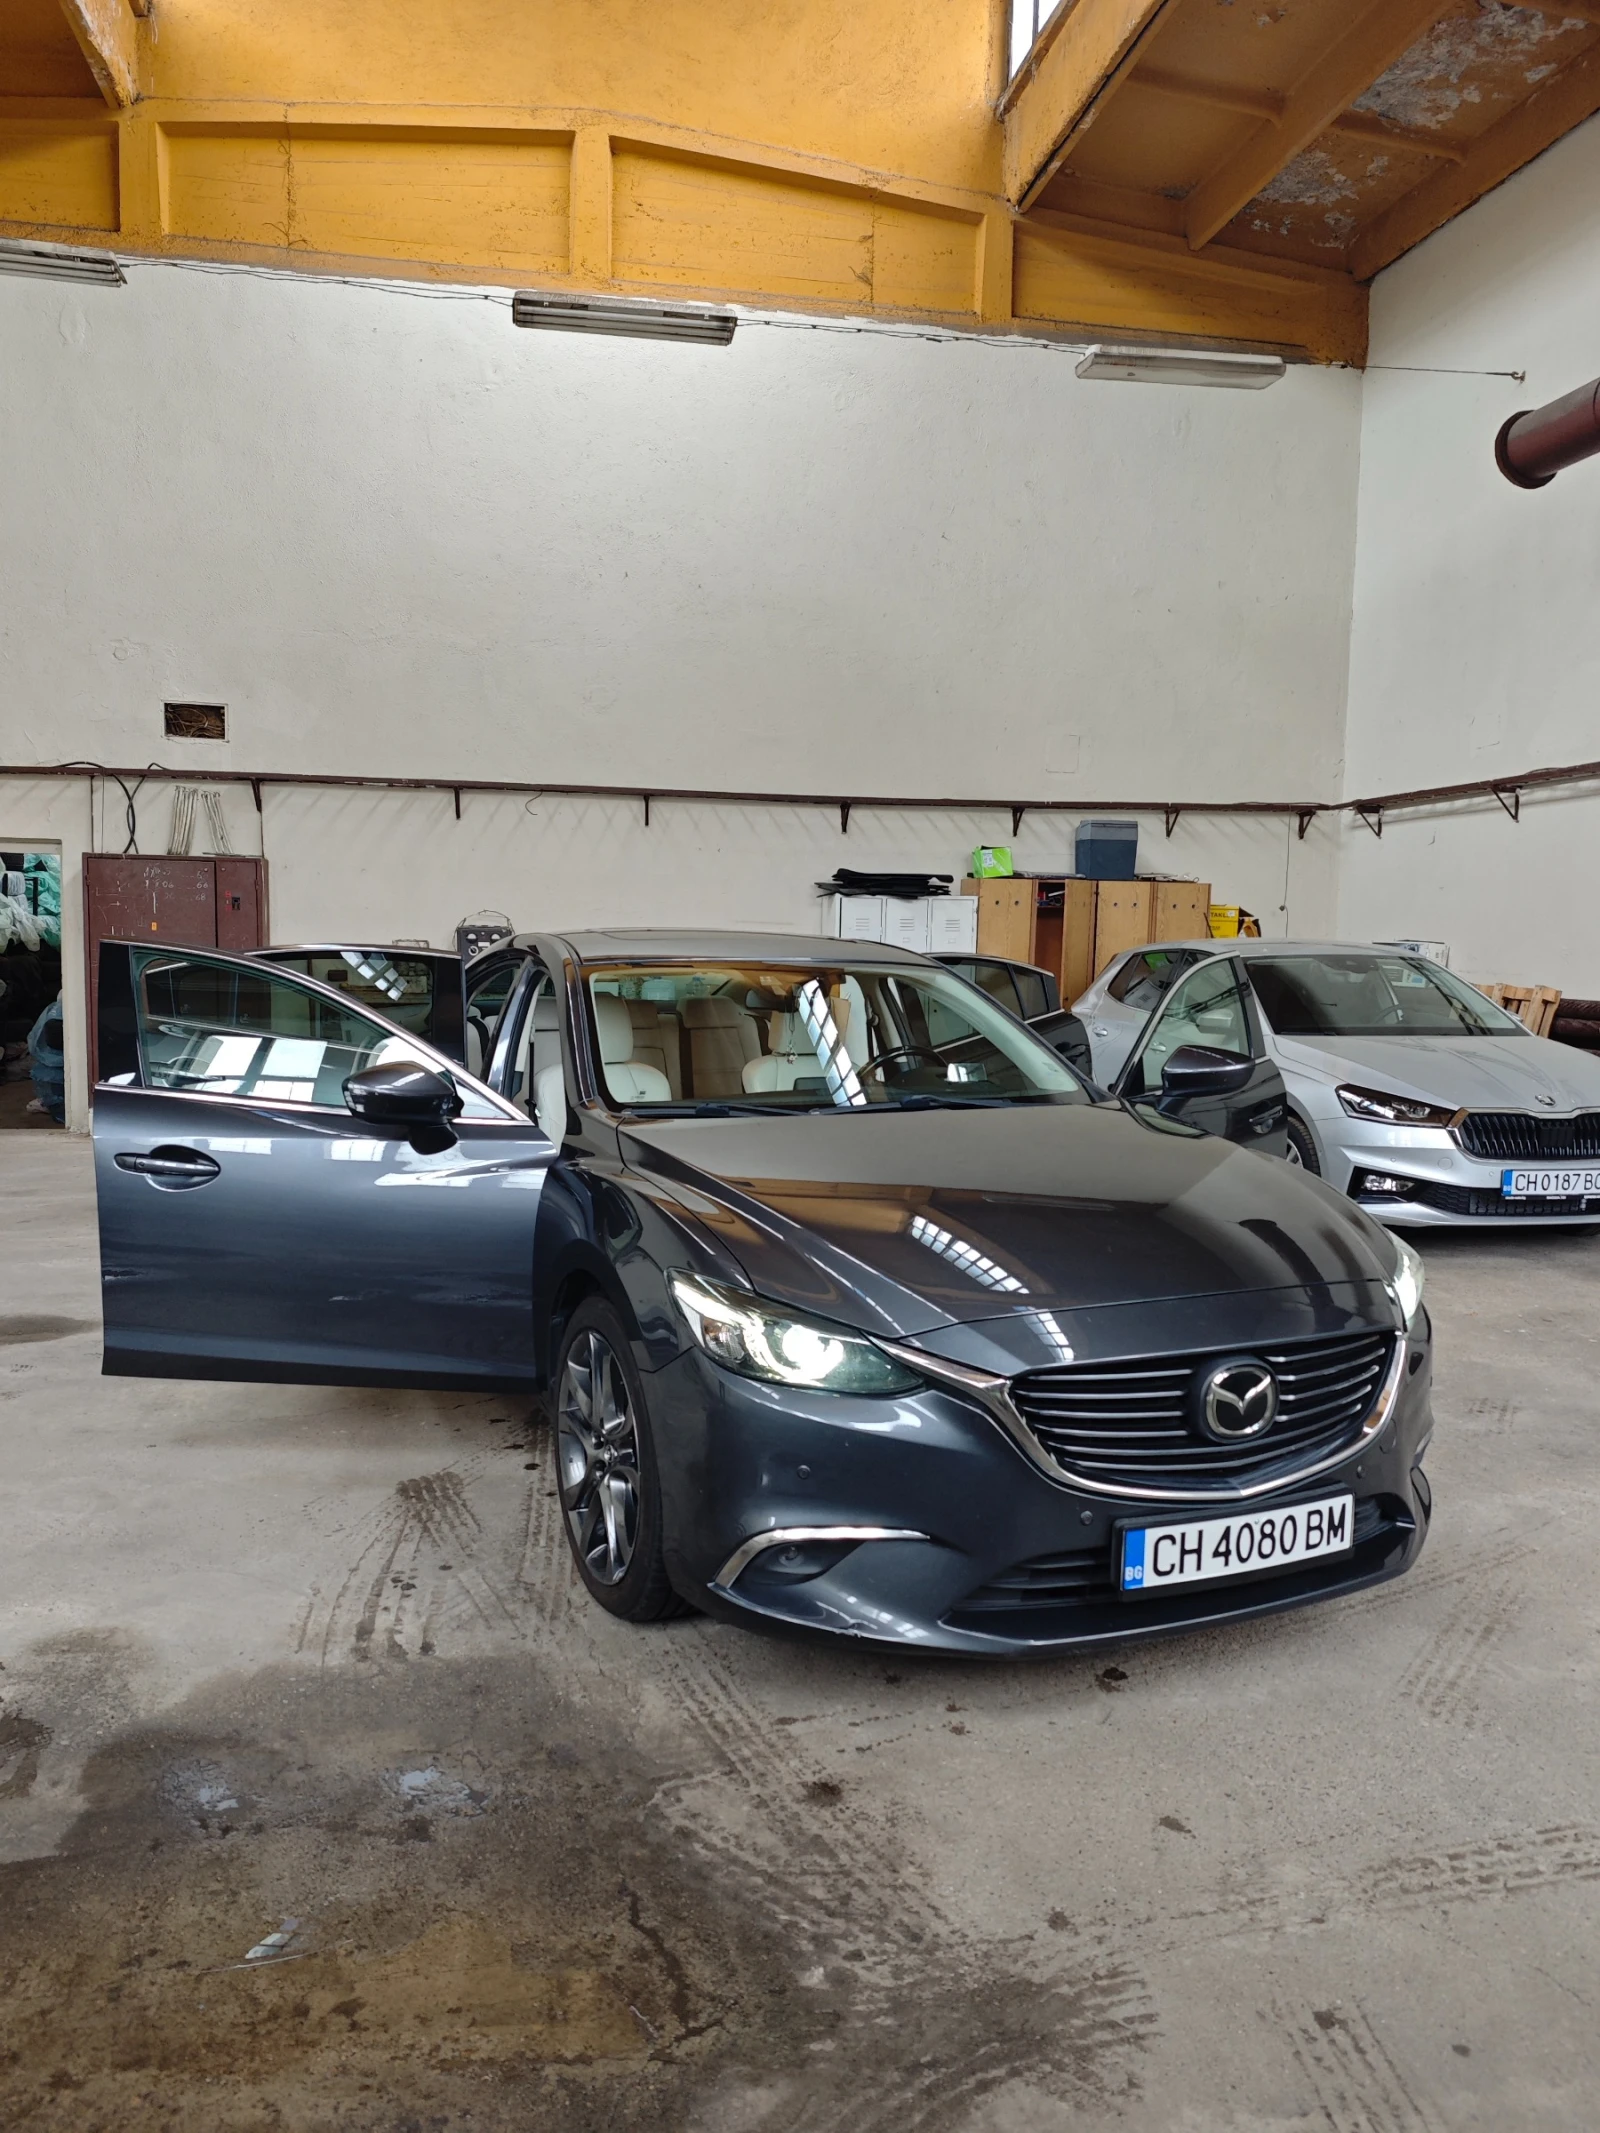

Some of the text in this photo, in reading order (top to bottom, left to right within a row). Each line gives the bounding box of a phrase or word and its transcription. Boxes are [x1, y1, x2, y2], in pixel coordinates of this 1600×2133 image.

[1515, 1174, 1538, 1191] CH
[1541, 1173, 1581, 1191] 0187
[1153, 1503, 1346, 1577] CH 4080 BM
[1124, 1565, 1143, 1581] BG
